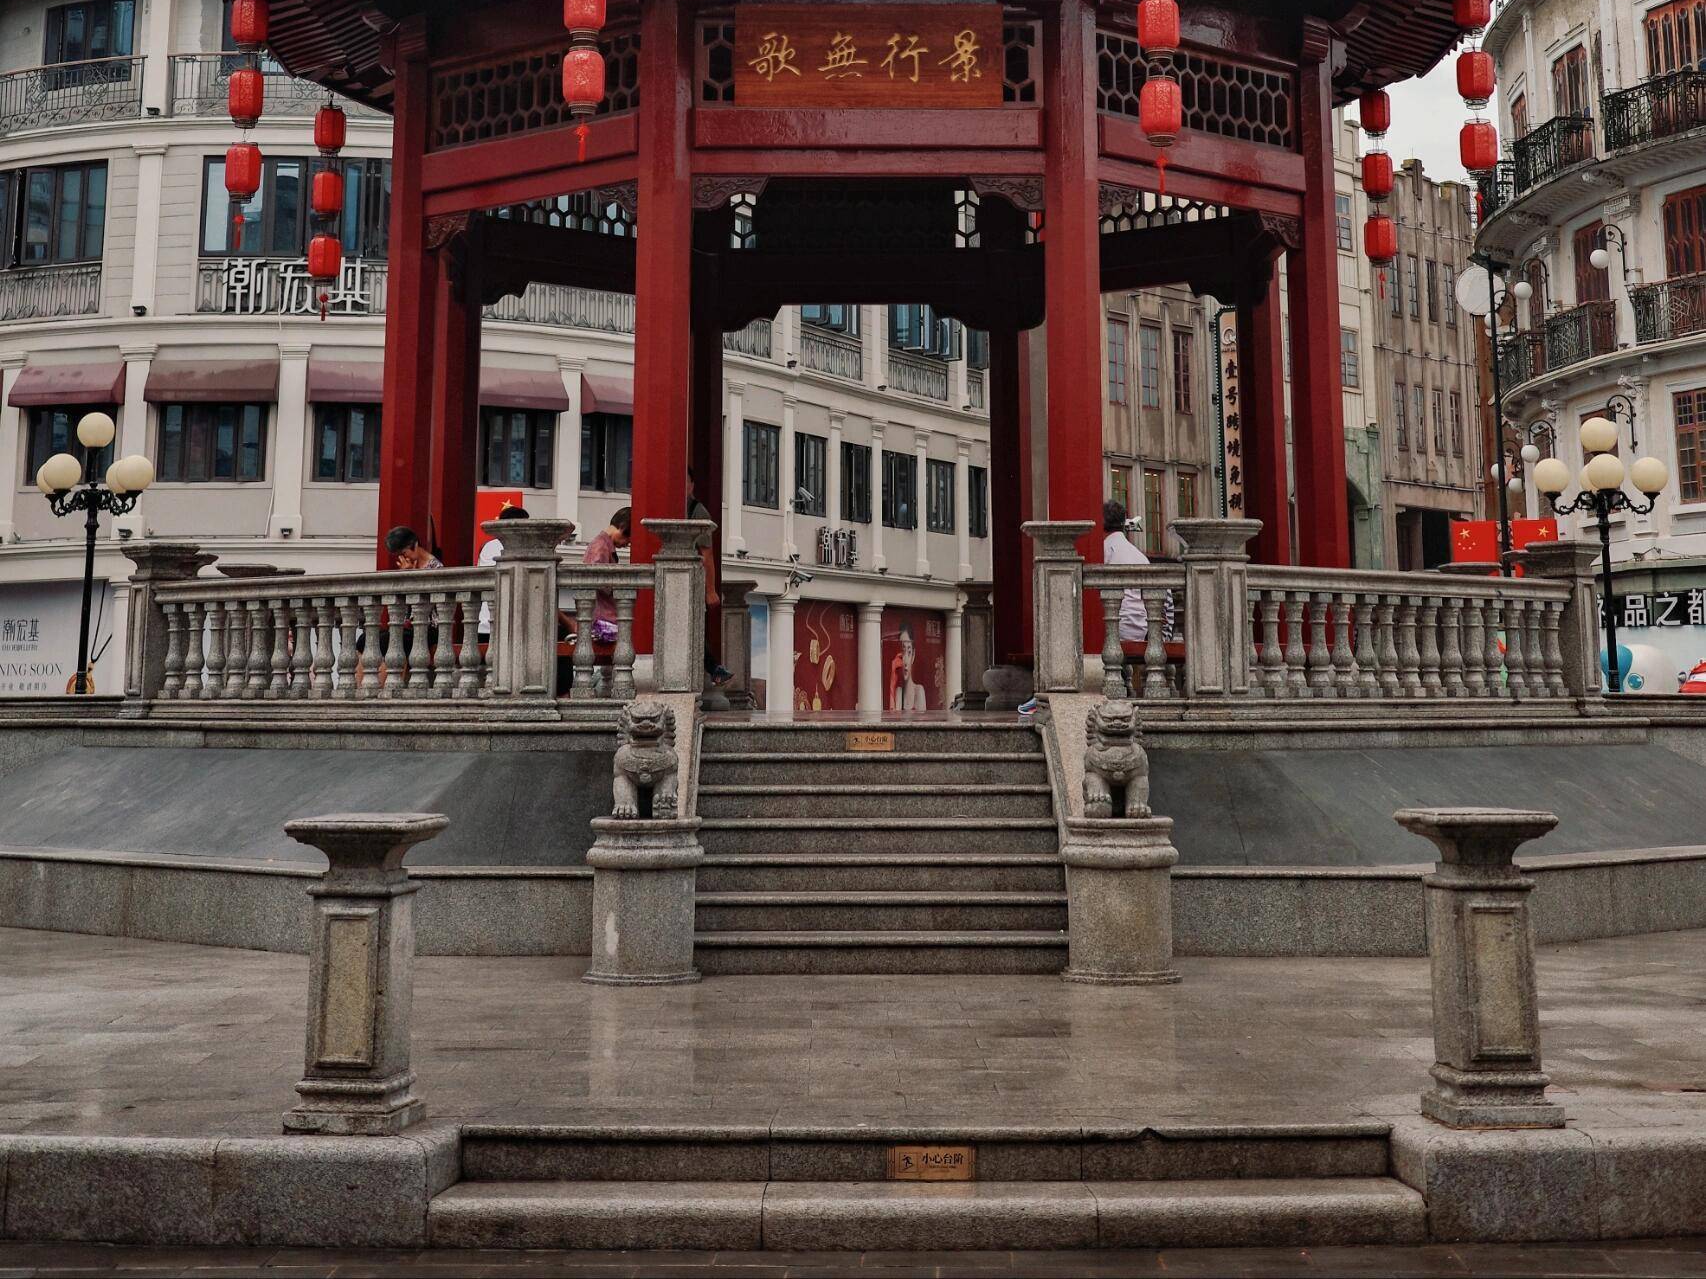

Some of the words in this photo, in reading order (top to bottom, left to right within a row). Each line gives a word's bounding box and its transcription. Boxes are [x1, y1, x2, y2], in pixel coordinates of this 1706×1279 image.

[221, 256, 371, 315] 潮宏基
[29, 663, 63, 676] SOON
[921, 1152, 964, 1165] 小心台阶
